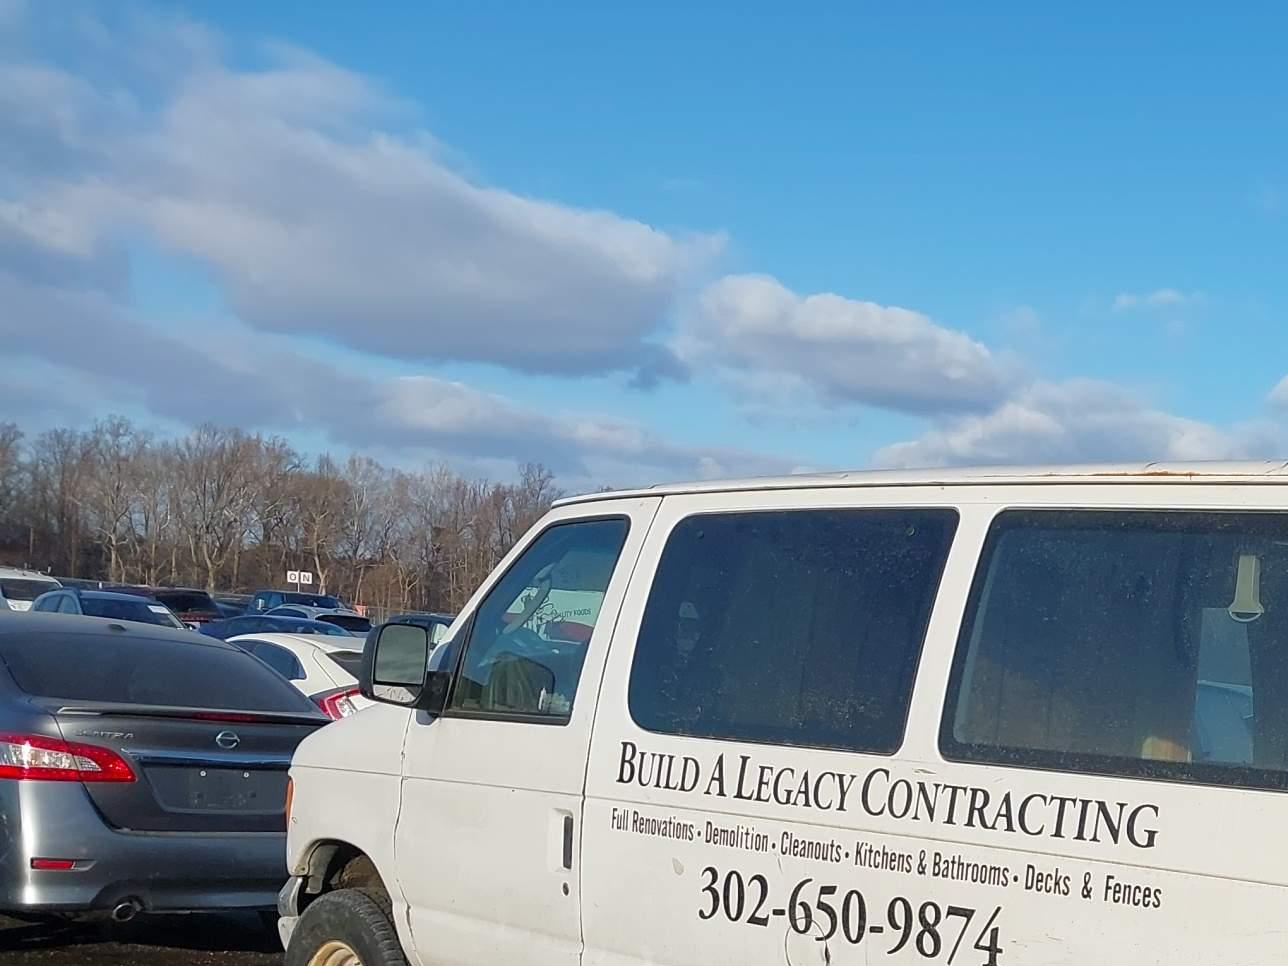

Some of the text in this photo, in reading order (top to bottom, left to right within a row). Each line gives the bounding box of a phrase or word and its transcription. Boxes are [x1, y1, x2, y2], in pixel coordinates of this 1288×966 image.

[704, 752, 727, 797] A
[611, 808, 1162, 909] Full Renovations Demolition Cleanouts Kitchens & Bathrooms Decks & Fences
